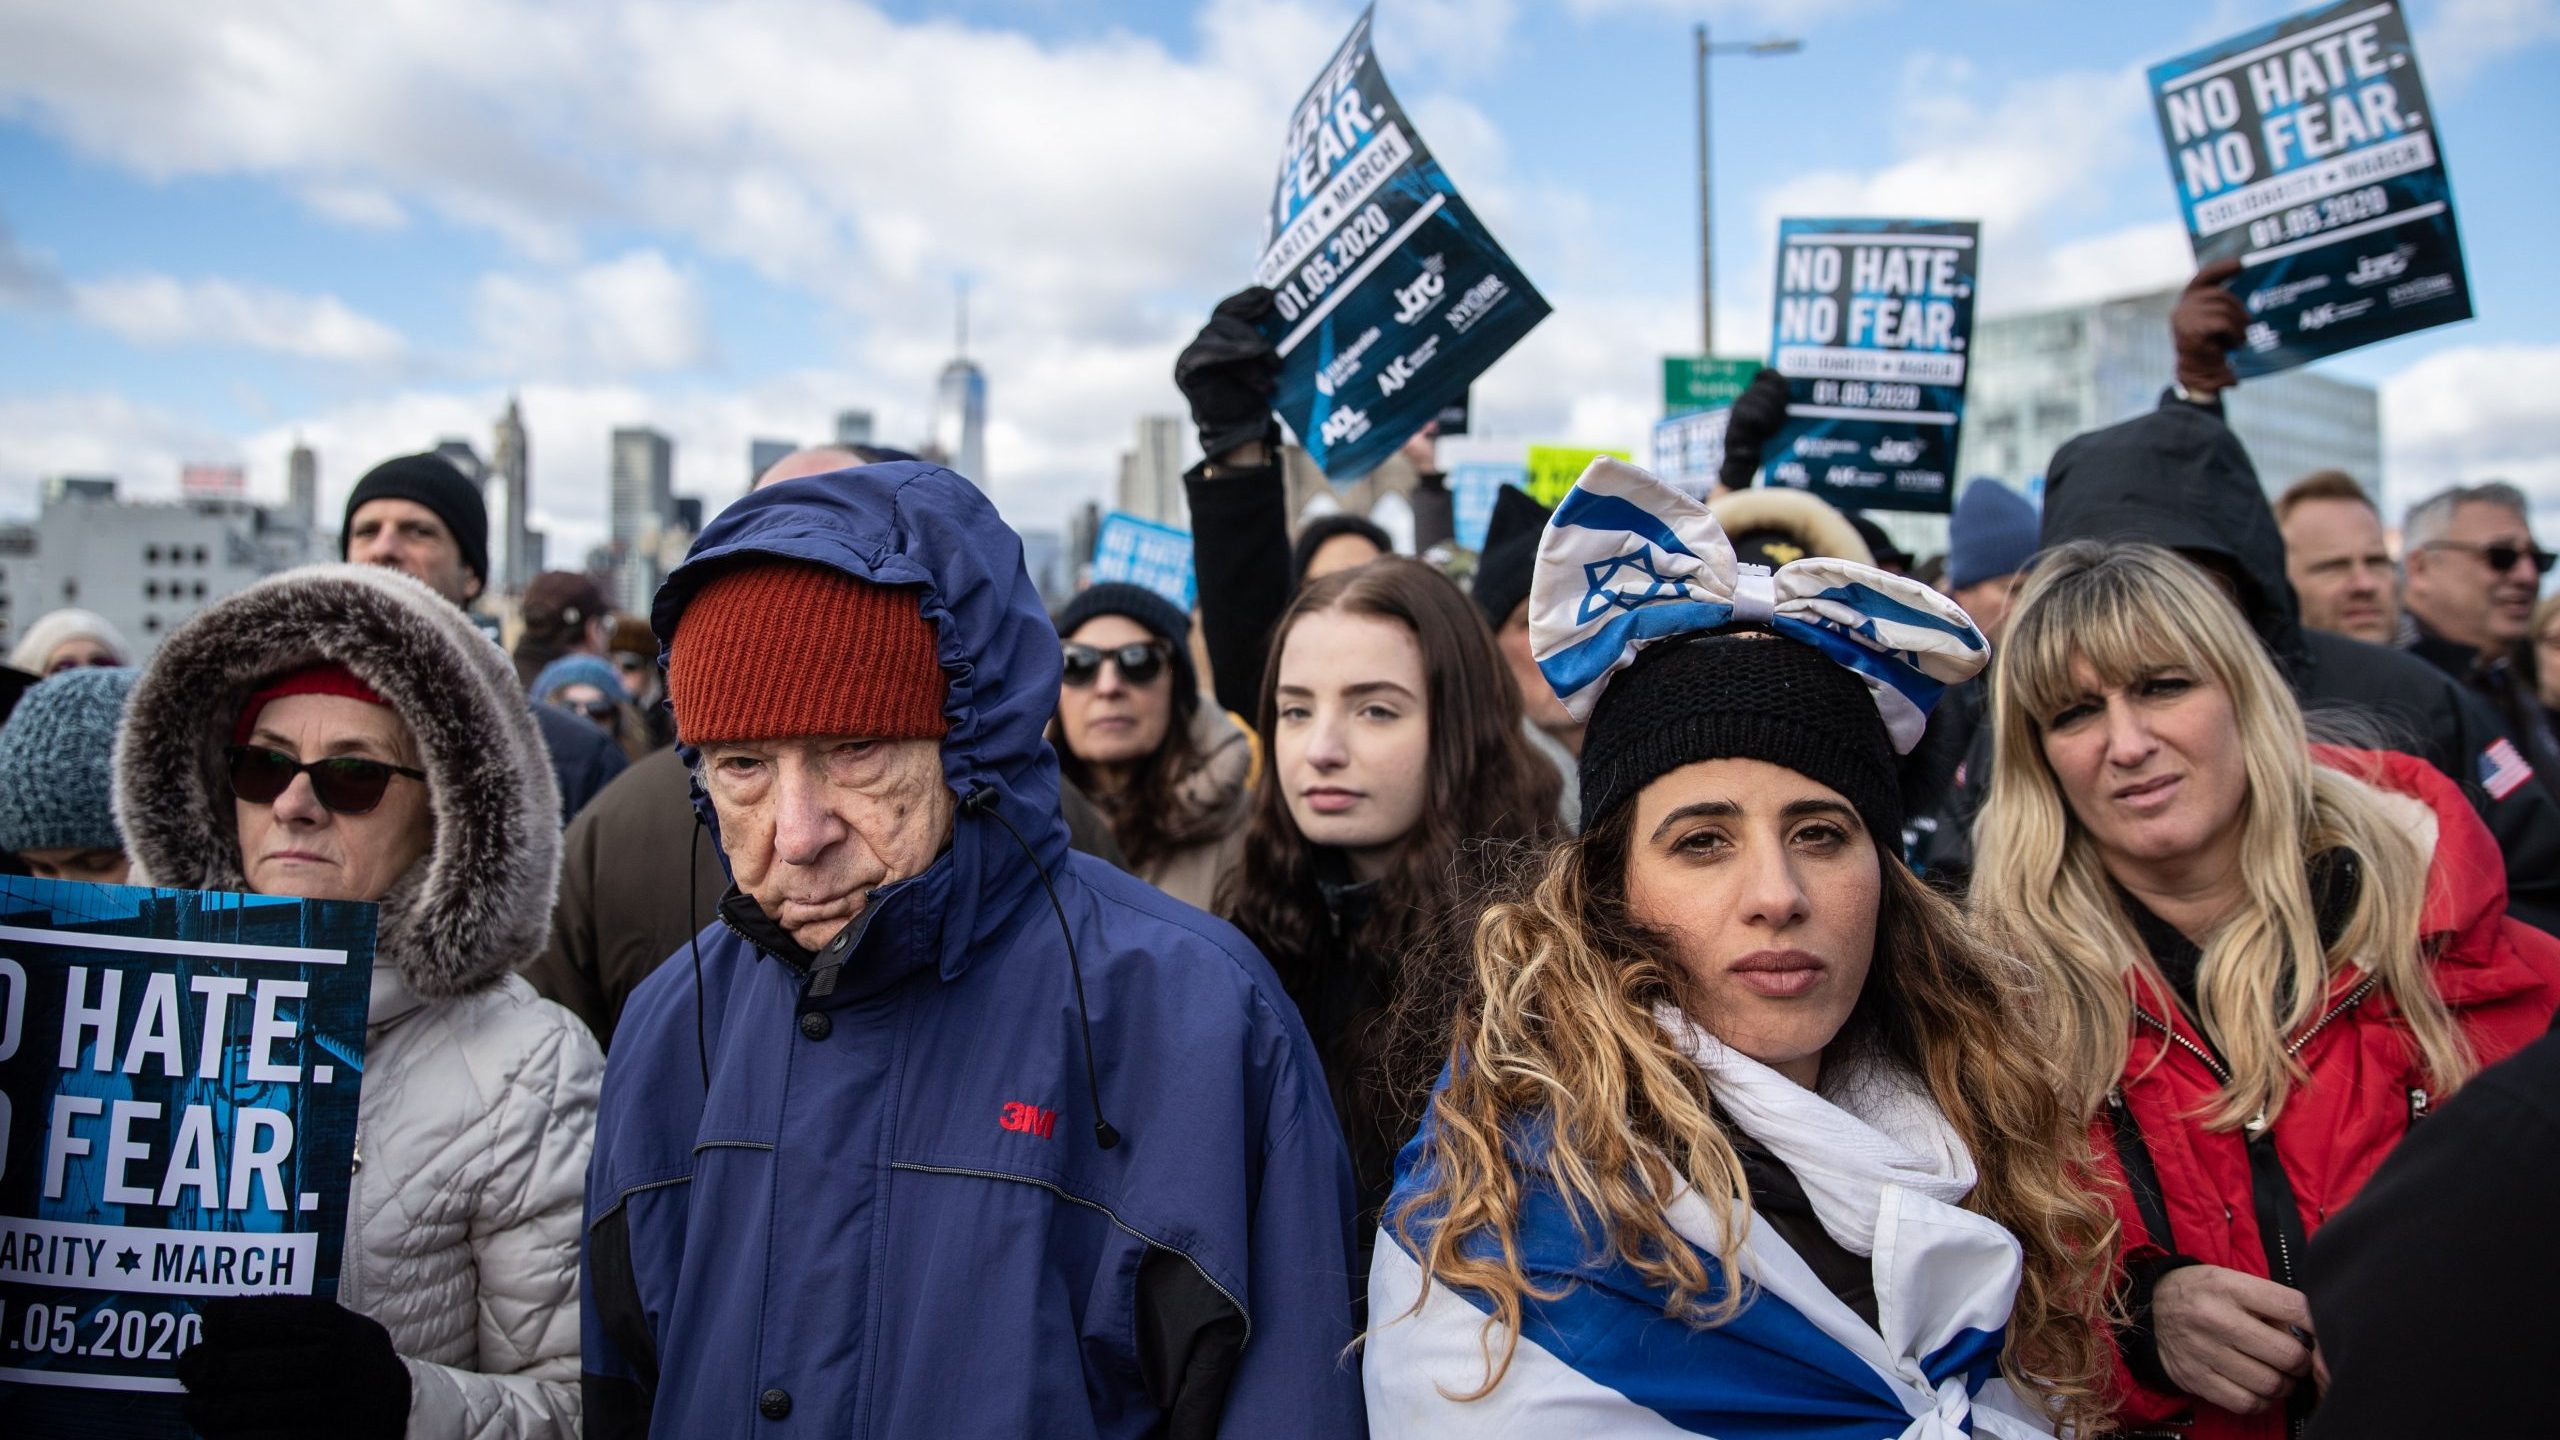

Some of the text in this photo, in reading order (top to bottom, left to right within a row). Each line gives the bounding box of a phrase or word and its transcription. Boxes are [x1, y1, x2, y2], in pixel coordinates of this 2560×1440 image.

[2165, 21, 2407, 146] NO HATE.
[2179, 80, 2424, 199] NO FEAR.
[1279, 87, 1386, 224] FEAR.
[1332, 138, 1400, 211] MARCH
[1275, 203, 1391, 322] 01.05.2020
[1782, 247, 1971, 298] NO HATE.
[1778, 296, 1966, 351] NO FEAR.
[59, 965, 335, 1084] HATE.
[43, 1094, 320, 1212] FEAR.
[999, 1101, 1056, 1140] 3M
[152, 1243, 295, 1286] MARCH
